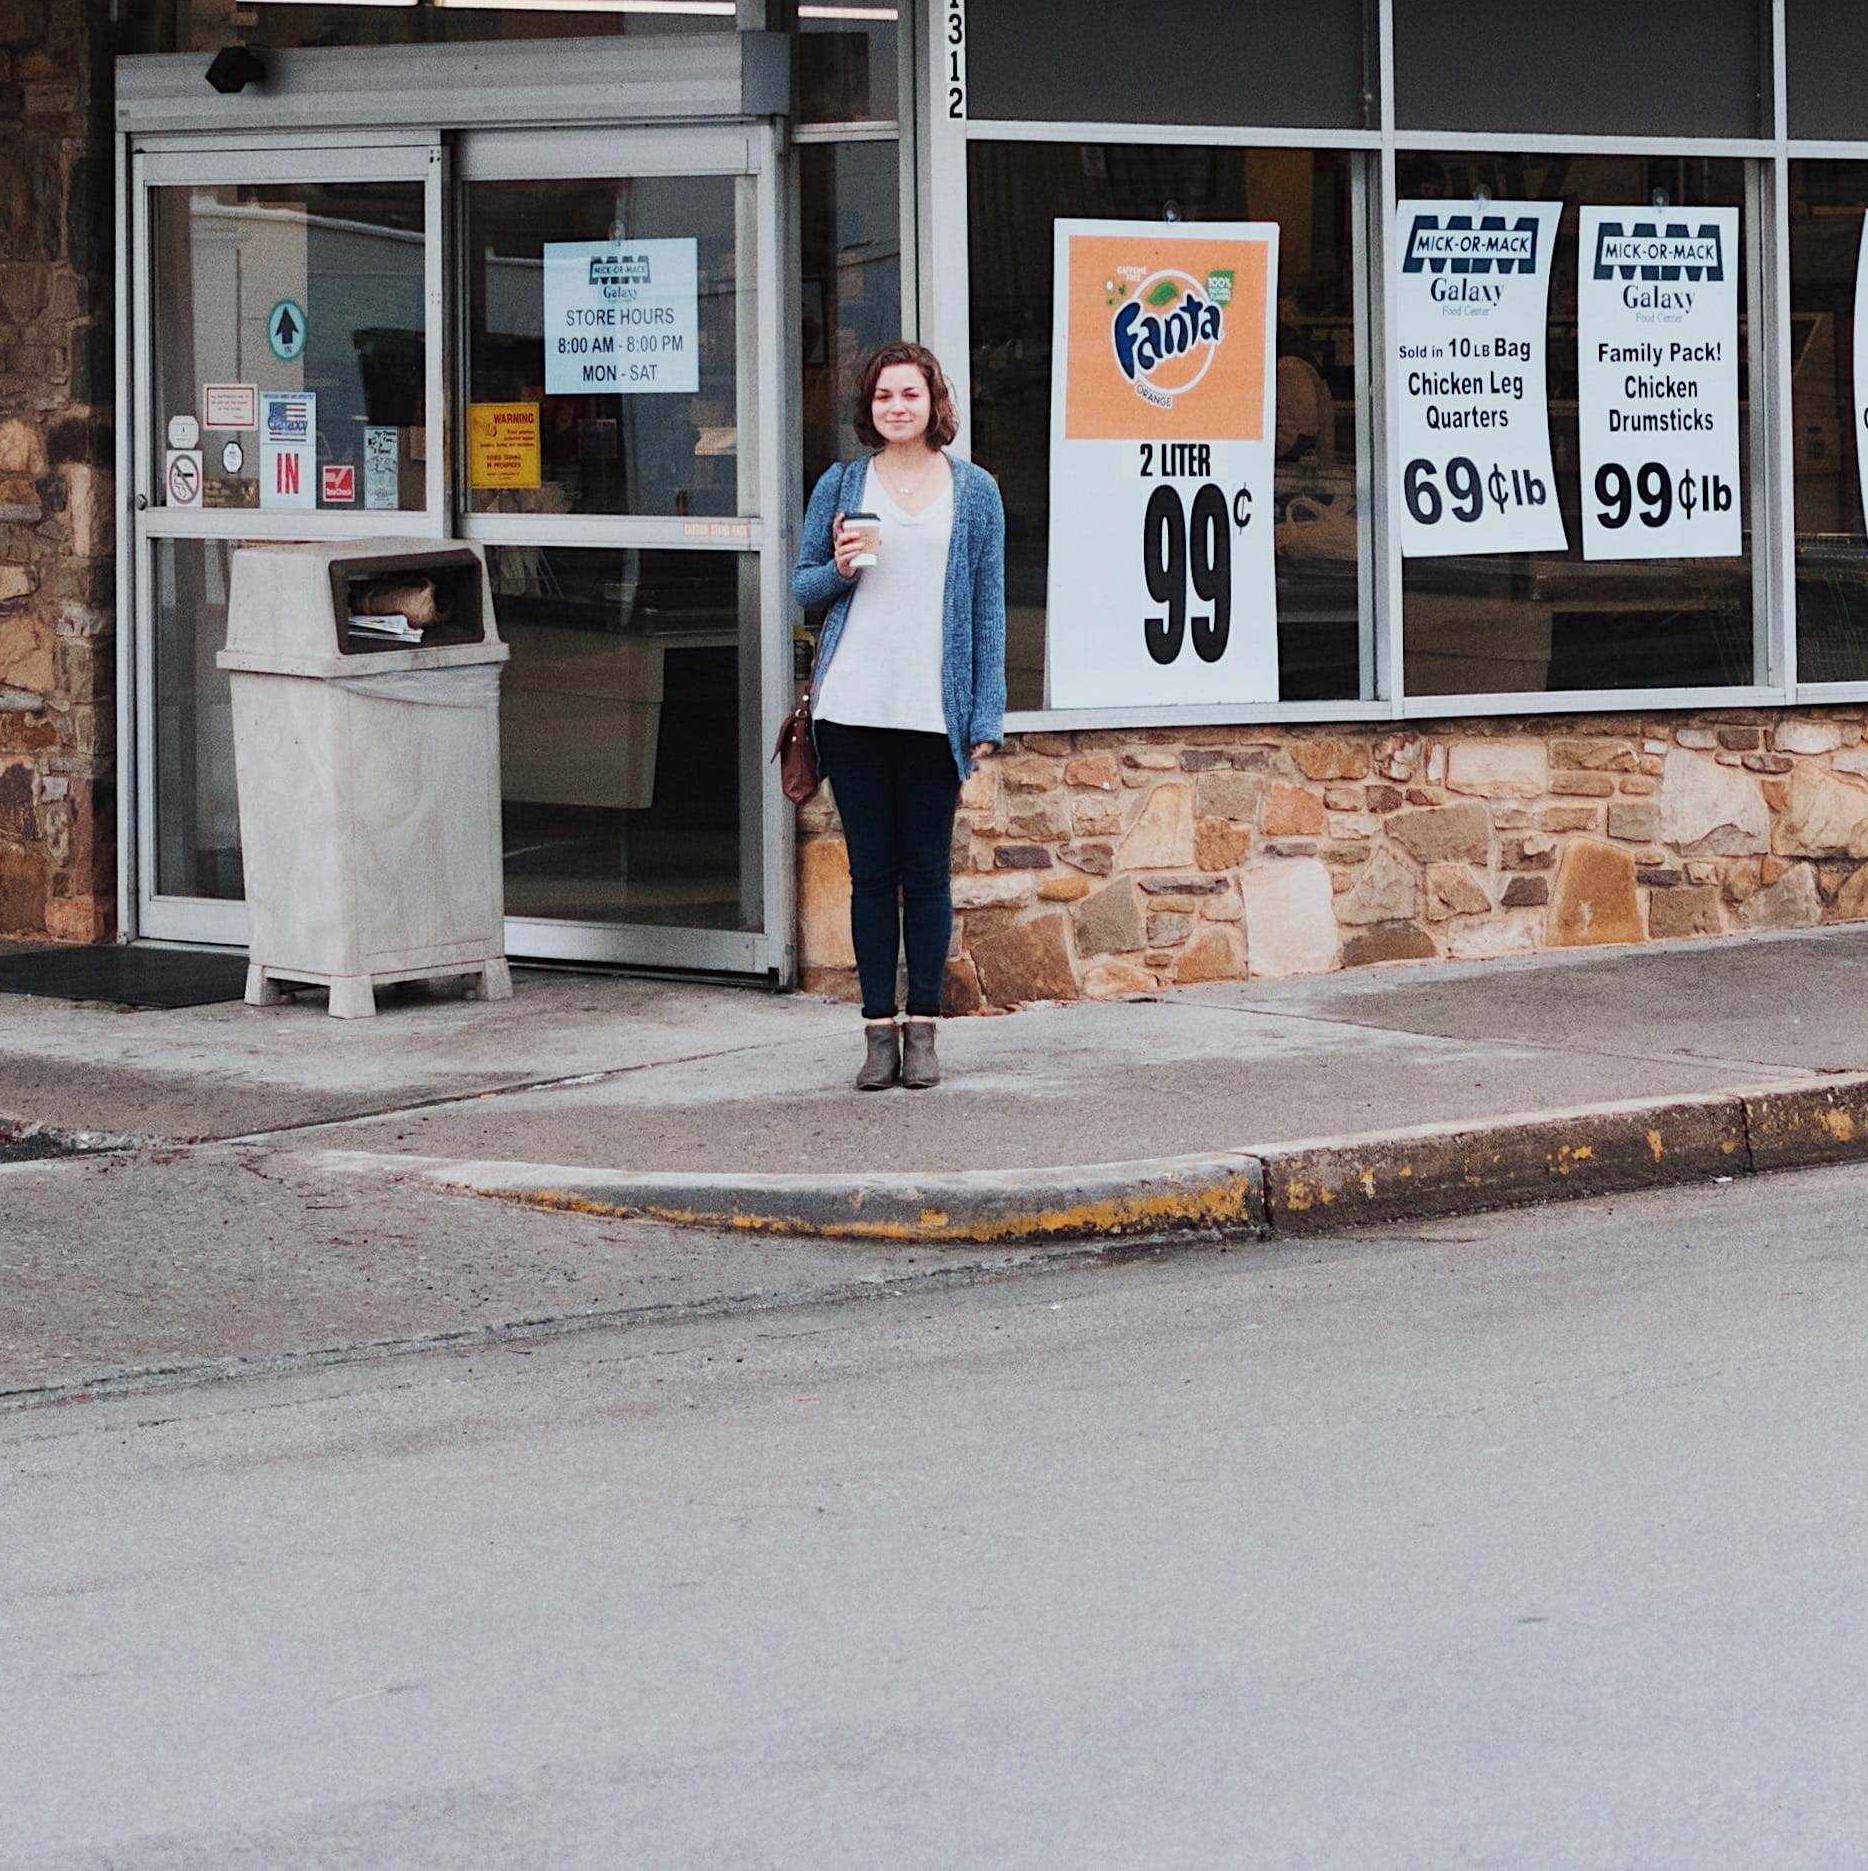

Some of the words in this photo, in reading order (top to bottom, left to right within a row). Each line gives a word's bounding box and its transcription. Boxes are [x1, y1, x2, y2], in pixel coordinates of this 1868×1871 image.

[1416, 235, 1530, 253] MICK-OR-MACK
[1605, 242, 1715, 260] MICK-OR-MACK
[603, 286, 638, 300] Galaxy
[1208, 277, 1232, 289] 100%
[1430, 277, 1504, 307] Galaxy
[1442, 305, 1462, 316] Food
[1622, 283, 1696, 314] Galaxy
[566, 309, 616, 327] STORE
[620, 307, 675, 326] HOURS
[1635, 312, 1655, 323] Food
[558, 336, 588, 354] 8:00
[592, 336, 614, 354] AM
[627, 335, 658, 352] 8:00
[662, 335, 684, 352] PM
[1113, 293, 1223, 381] Fanta
[1398, 345, 1428, 359] Sold
[1431, 345, 1443, 358] in
[1448, 337, 1471, 358] 10
[1474, 344, 1490, 357] LB
[1494, 337, 1531, 362] Bag
[1598, 342, 1663, 368] Family
[1670, 342, 1722, 362] Pack!
[583, 365, 617, 382] MON
[629, 364, 658, 380] SAT
[1407, 371, 1483, 396] Chicken
[1490, 370, 1524, 400] Leg
[1136, 384, 1172, 408] ORANGE
[1624, 375, 1698, 399] Chicken
[493, 412, 535, 424] WARNING
[1426, 405, 1509, 430] Quarters
[1609, 408, 1714, 433] Drumsticks
[1139, 443, 1153, 477] 2
[1160, 443, 1212, 477] LITER
[276, 452, 300, 495] IN
